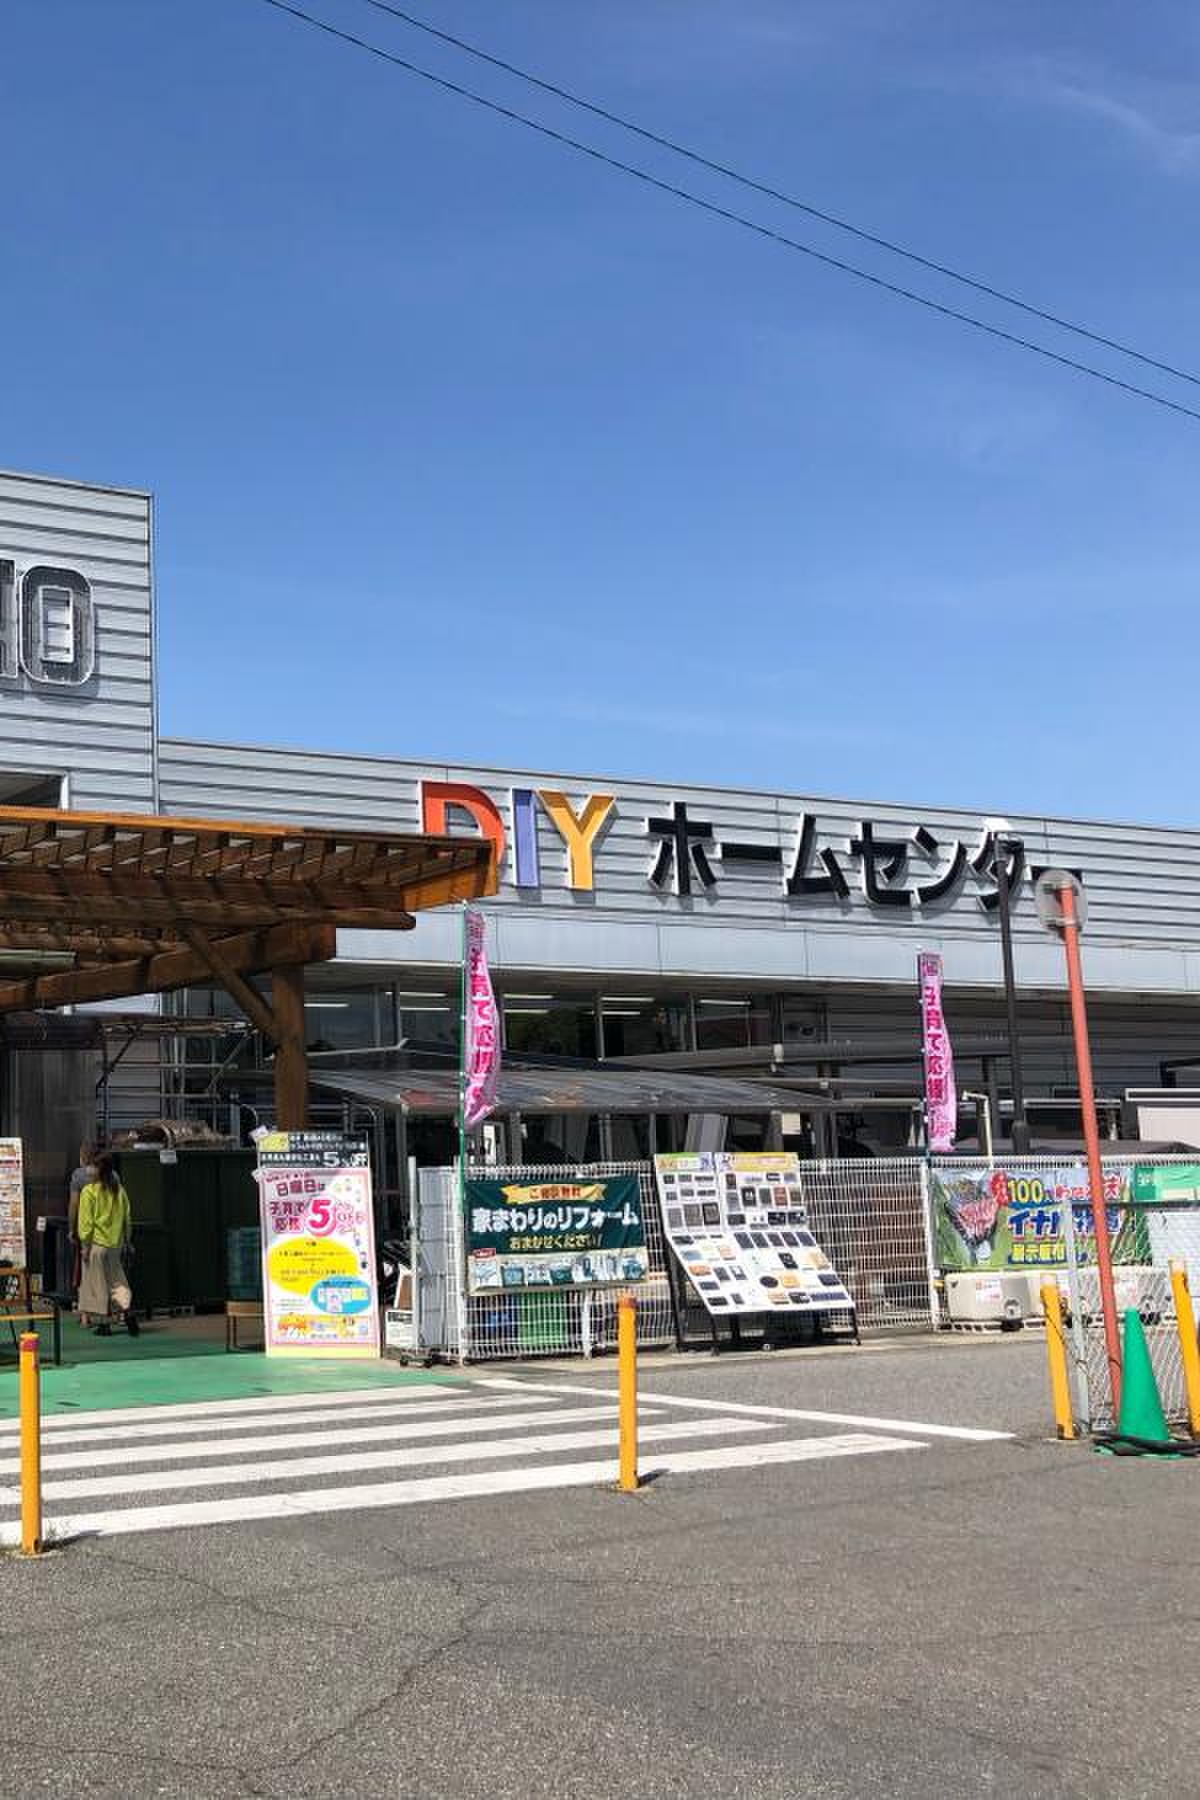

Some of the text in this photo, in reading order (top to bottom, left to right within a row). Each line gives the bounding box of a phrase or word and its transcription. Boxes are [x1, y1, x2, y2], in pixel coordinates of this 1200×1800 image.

[418, 780, 615, 890] DIY
[471, 1202, 640, 1233] 家まわりのリフォーム
